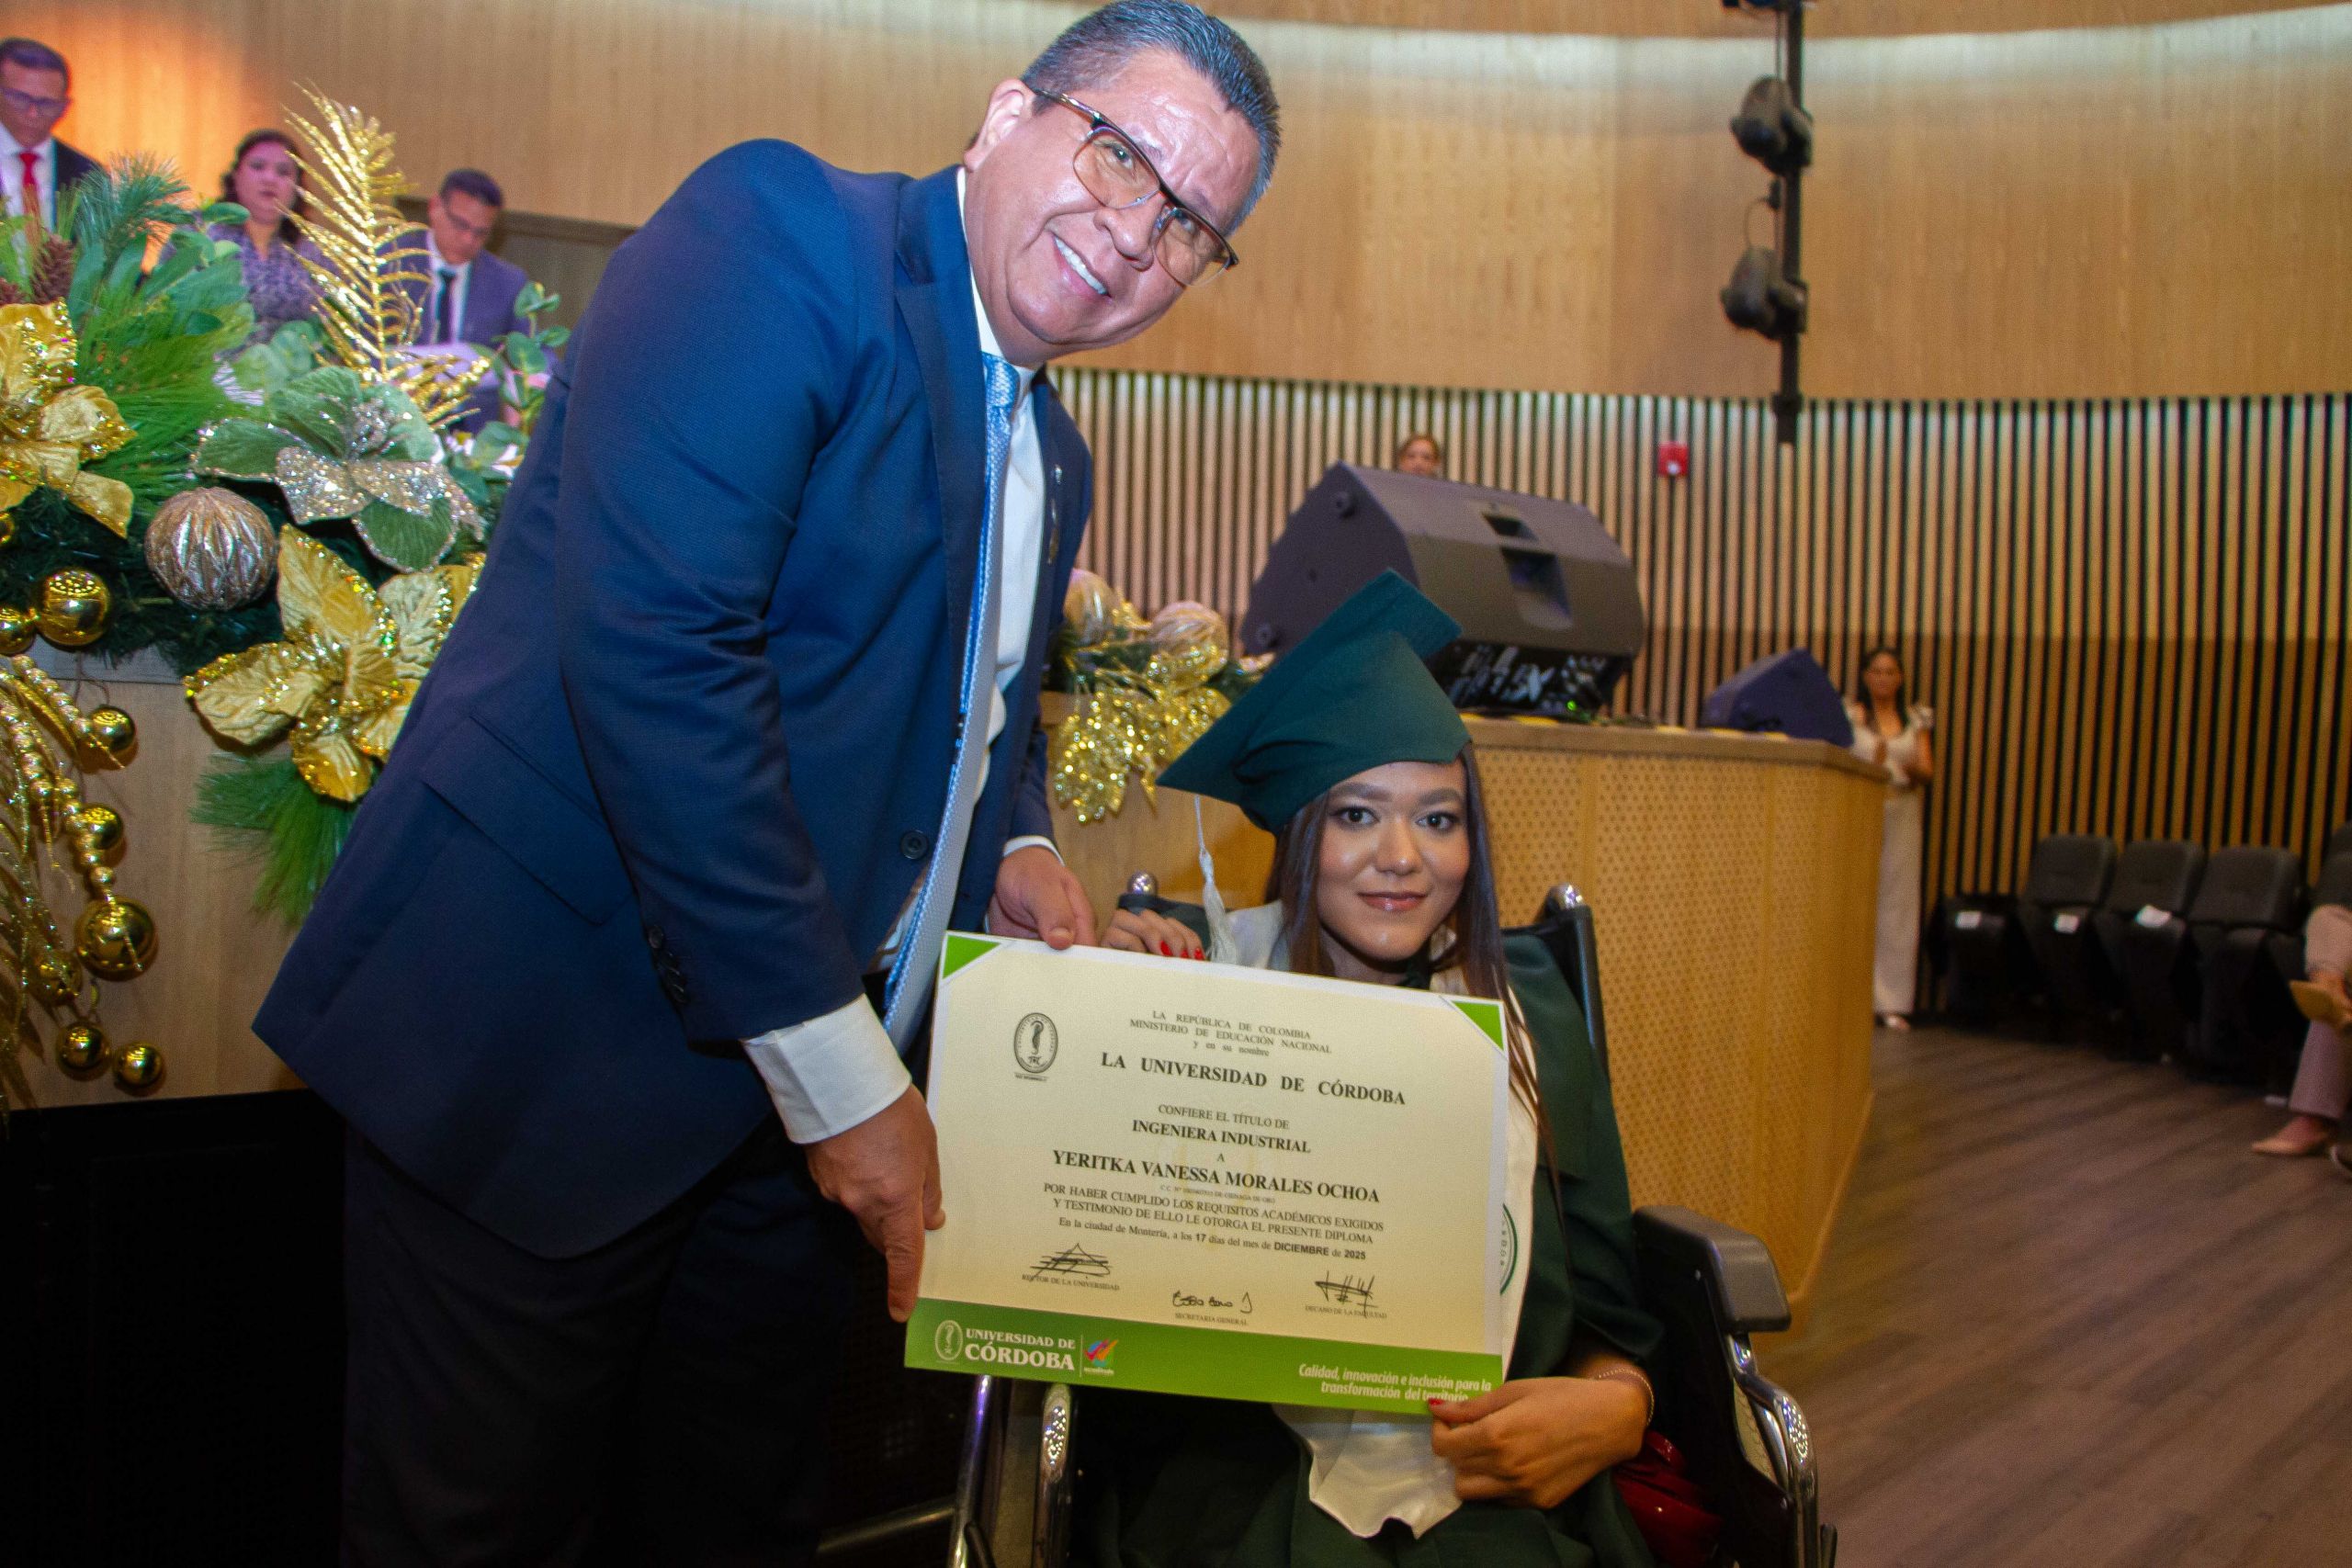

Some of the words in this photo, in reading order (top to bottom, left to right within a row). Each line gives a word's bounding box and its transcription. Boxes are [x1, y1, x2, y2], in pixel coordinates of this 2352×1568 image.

[1130, 1019, 1188, 1034] MINISTERIO
[1195, 1028, 1209, 1037] DE
[1216, 1030, 1274, 1045] EDUCACIÓN
[1281, 1040, 1332, 1054] NACIONAL
[1153, 1010, 1166, 1020] LA
[1176, 1012, 1231, 1029] REPÚBLICA
[1238, 1021, 1252, 1032] DE
[1259, 1025, 1311, 1040] COLOMBIA
[1223, 1043, 1232, 1052] su
[1238, 1045, 1270, 1056] nombre
[1102, 1052, 1126, 1068] LA
[1141, 1057, 1267, 1087] UNIVERSIDAD
[1281, 1076, 1305, 1092] DE
[1317, 1078, 1406, 1105] CÓRDOBA
[1158, 1104, 1213, 1120] CONFIERE
[1216, 1111, 1229, 1122] EL
[1232, 1112, 1272, 1127] TÍTULO
[1275, 1119, 1290, 1130] DE
[1132, 1119, 1217, 1142] INGENIERA
[1221, 1131, 1311, 1154] INDUSTRIAL
[1216, 1153, 1226, 1162] A
[1053, 1150, 1136, 1174] YERITKA
[1141, 1160, 1220, 1184] VANESSA
[1225, 1170, 1313, 1195] MORALES
[1317, 1182, 1380, 1203] OCHOA
[1044, 1182, 1066, 1194] POR
[1069, 1185, 1107, 1200] HABER
[1111, 1190, 1170, 1207] CUMPLIDO
[1173, 1198, 1194, 1210] LOS
[1196, 1201, 1260, 1218] REQUISITOS
[1261, 1208, 1332, 1226] ACADÉMICOS
[1334, 1217, 1385, 1232] EXIGIDOS
[1053, 1199, 1061, 1208] Y
[1065, 1200, 1133, 1216] TESTIMONIO
[1136, 1208, 1151, 1219] DE
[1154, 1211, 1183, 1223] ELLO
[1186, 1214, 1200, 1224] LE
[1203, 1216, 1248, 1231] OTORGA
[1251, 1222, 1265, 1233] EL
[1268, 1224, 1322, 1239] PRESENTE
[1325, 1230, 1374, 1244] DIPLOMA
[1058, 1217, 1071, 1226] En
[1074, 1219, 1082, 1228] la
[1084, 1221, 1113, 1232] ciudad
[1115, 1224, 1126, 1233] de
[1181, 1232, 1193, 1241] los
[1195, 1233, 1206, 1243] 17
[1208, 1235, 1226, 1245] días
[1227, 1236, 1240, 1247] del
[1243, 1240, 1259, 1248] mes
[1261, 1240, 1272, 1250] de
[1273, 1241, 1329, 1257] DICIEMBRE
[1331, 1248, 1341, 1258] de
[1344, 1249, 1366, 1260] 2025
[966, 1327, 1054, 1348] UNIVERSIDAD
[1057, 1338, 1076, 1349] DE
[965, 1341, 1075, 1371] CÓRDOBA
[1298, 1363, 1340, 1381] Calidad,
[1342, 1367, 1398, 1385] innovación
[1400, 1376, 1407, 1385] e
[1408, 1373, 1453, 1389] inclusión
[1454, 1380, 1480, 1393] para
[1481, 1378, 1491, 1392] la
[1321, 1382, 1401, 1399] transformación
[1405, 1388, 1420, 1401] del
